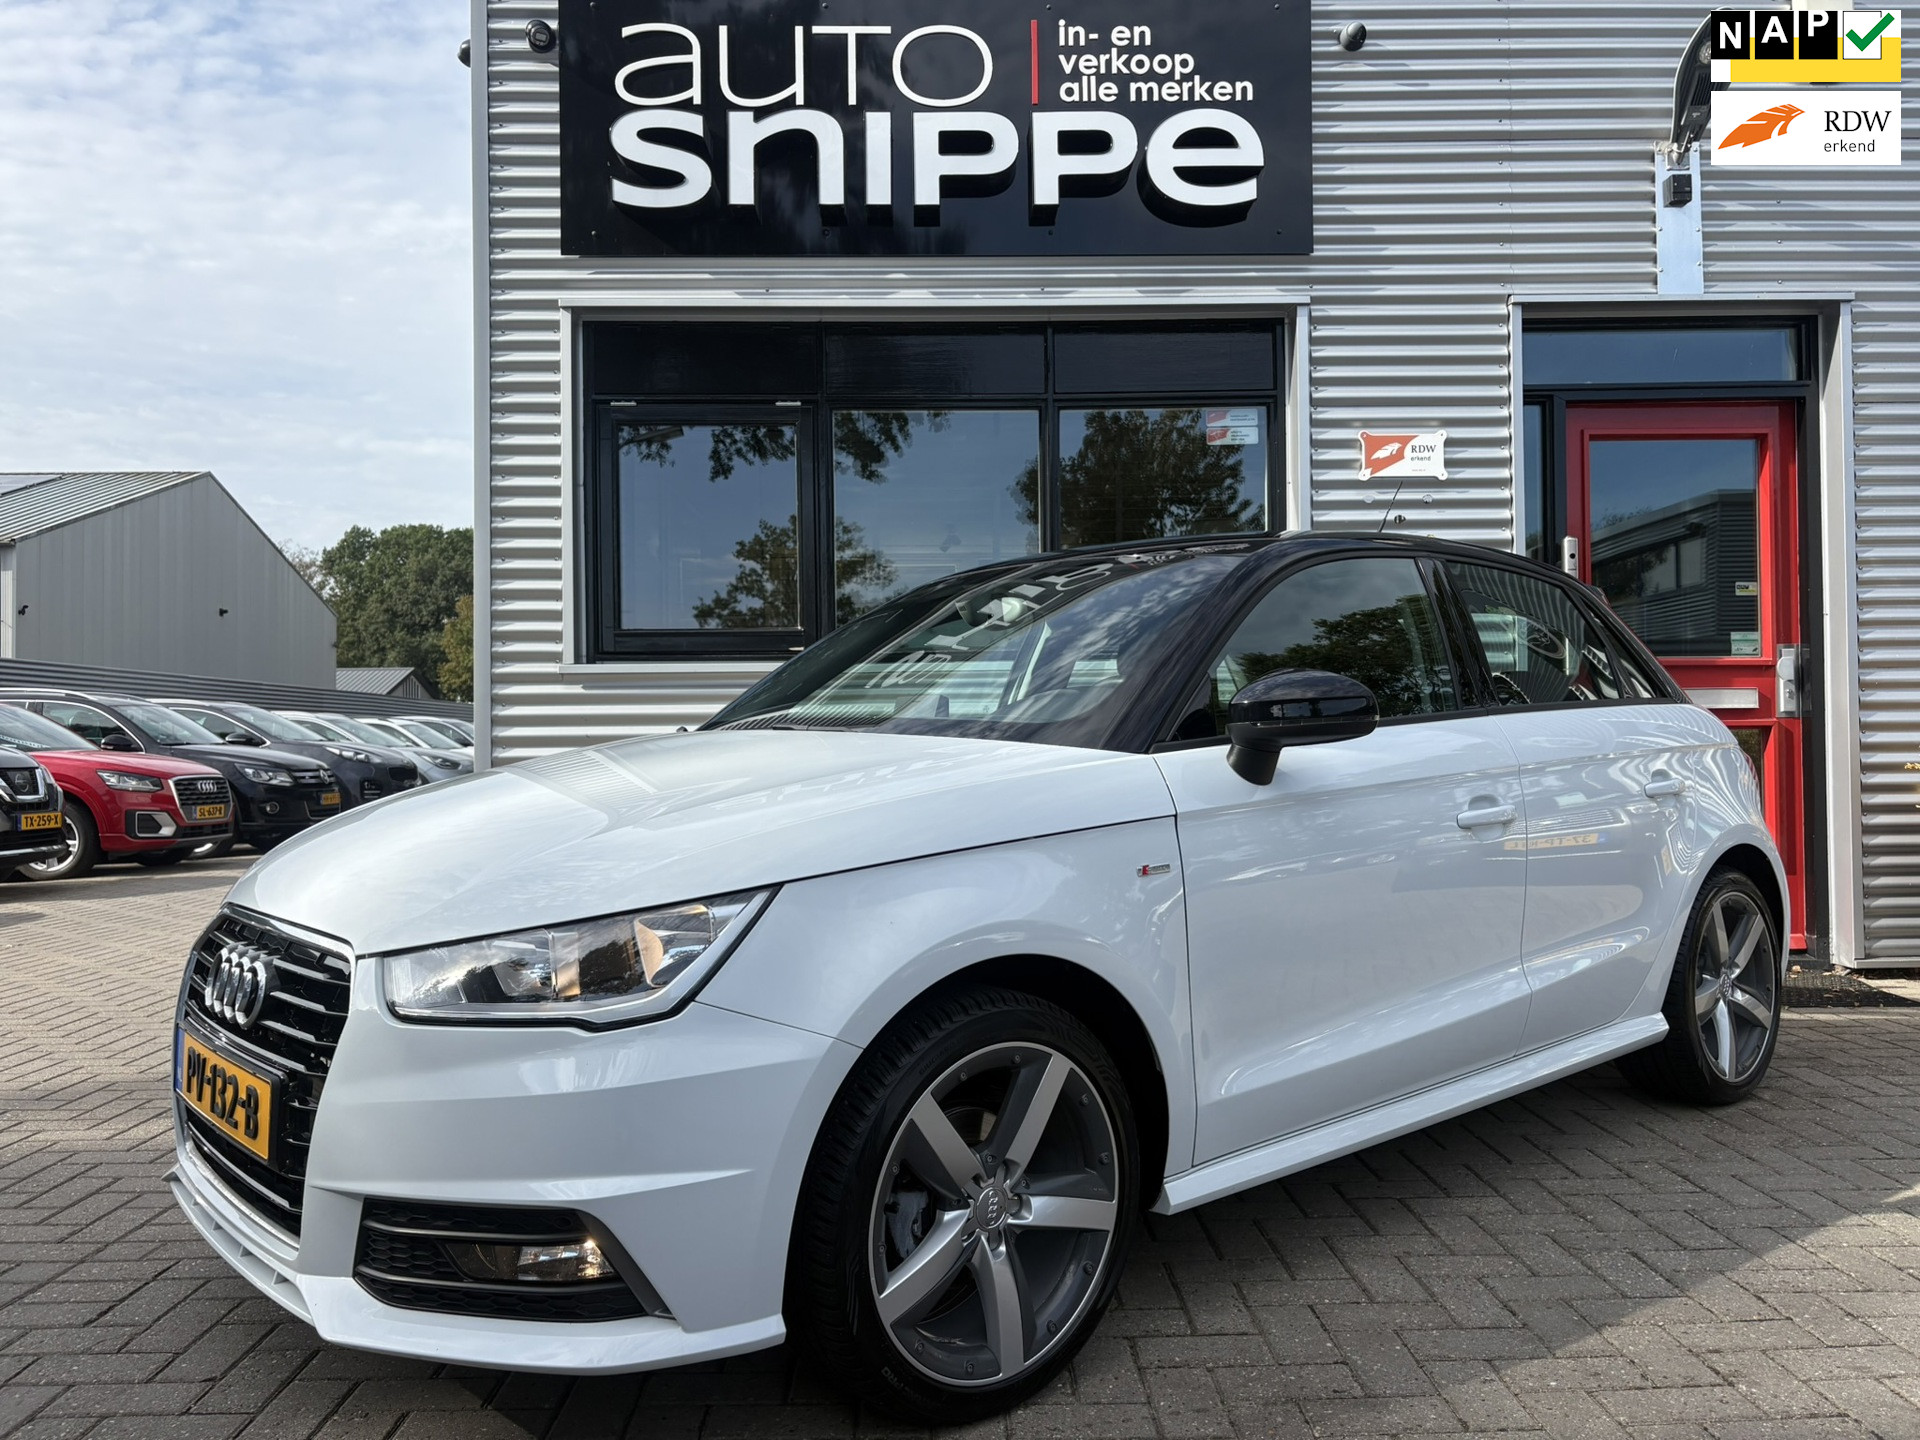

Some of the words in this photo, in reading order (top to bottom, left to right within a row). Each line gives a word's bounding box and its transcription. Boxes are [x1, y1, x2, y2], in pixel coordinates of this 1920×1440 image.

[1058, 19, 1100, 47] in-
[1110, 25, 1152, 47] en
[1058, 50, 1194, 78] verkoop
[1059, 75, 1118, 102] alle
[1129, 76, 1254, 102] merken
[1411, 445, 1436, 453] RDW
[24, 814, 59, 828] TX-259-X
[186, 1046, 260, 1141] PV-132-B
